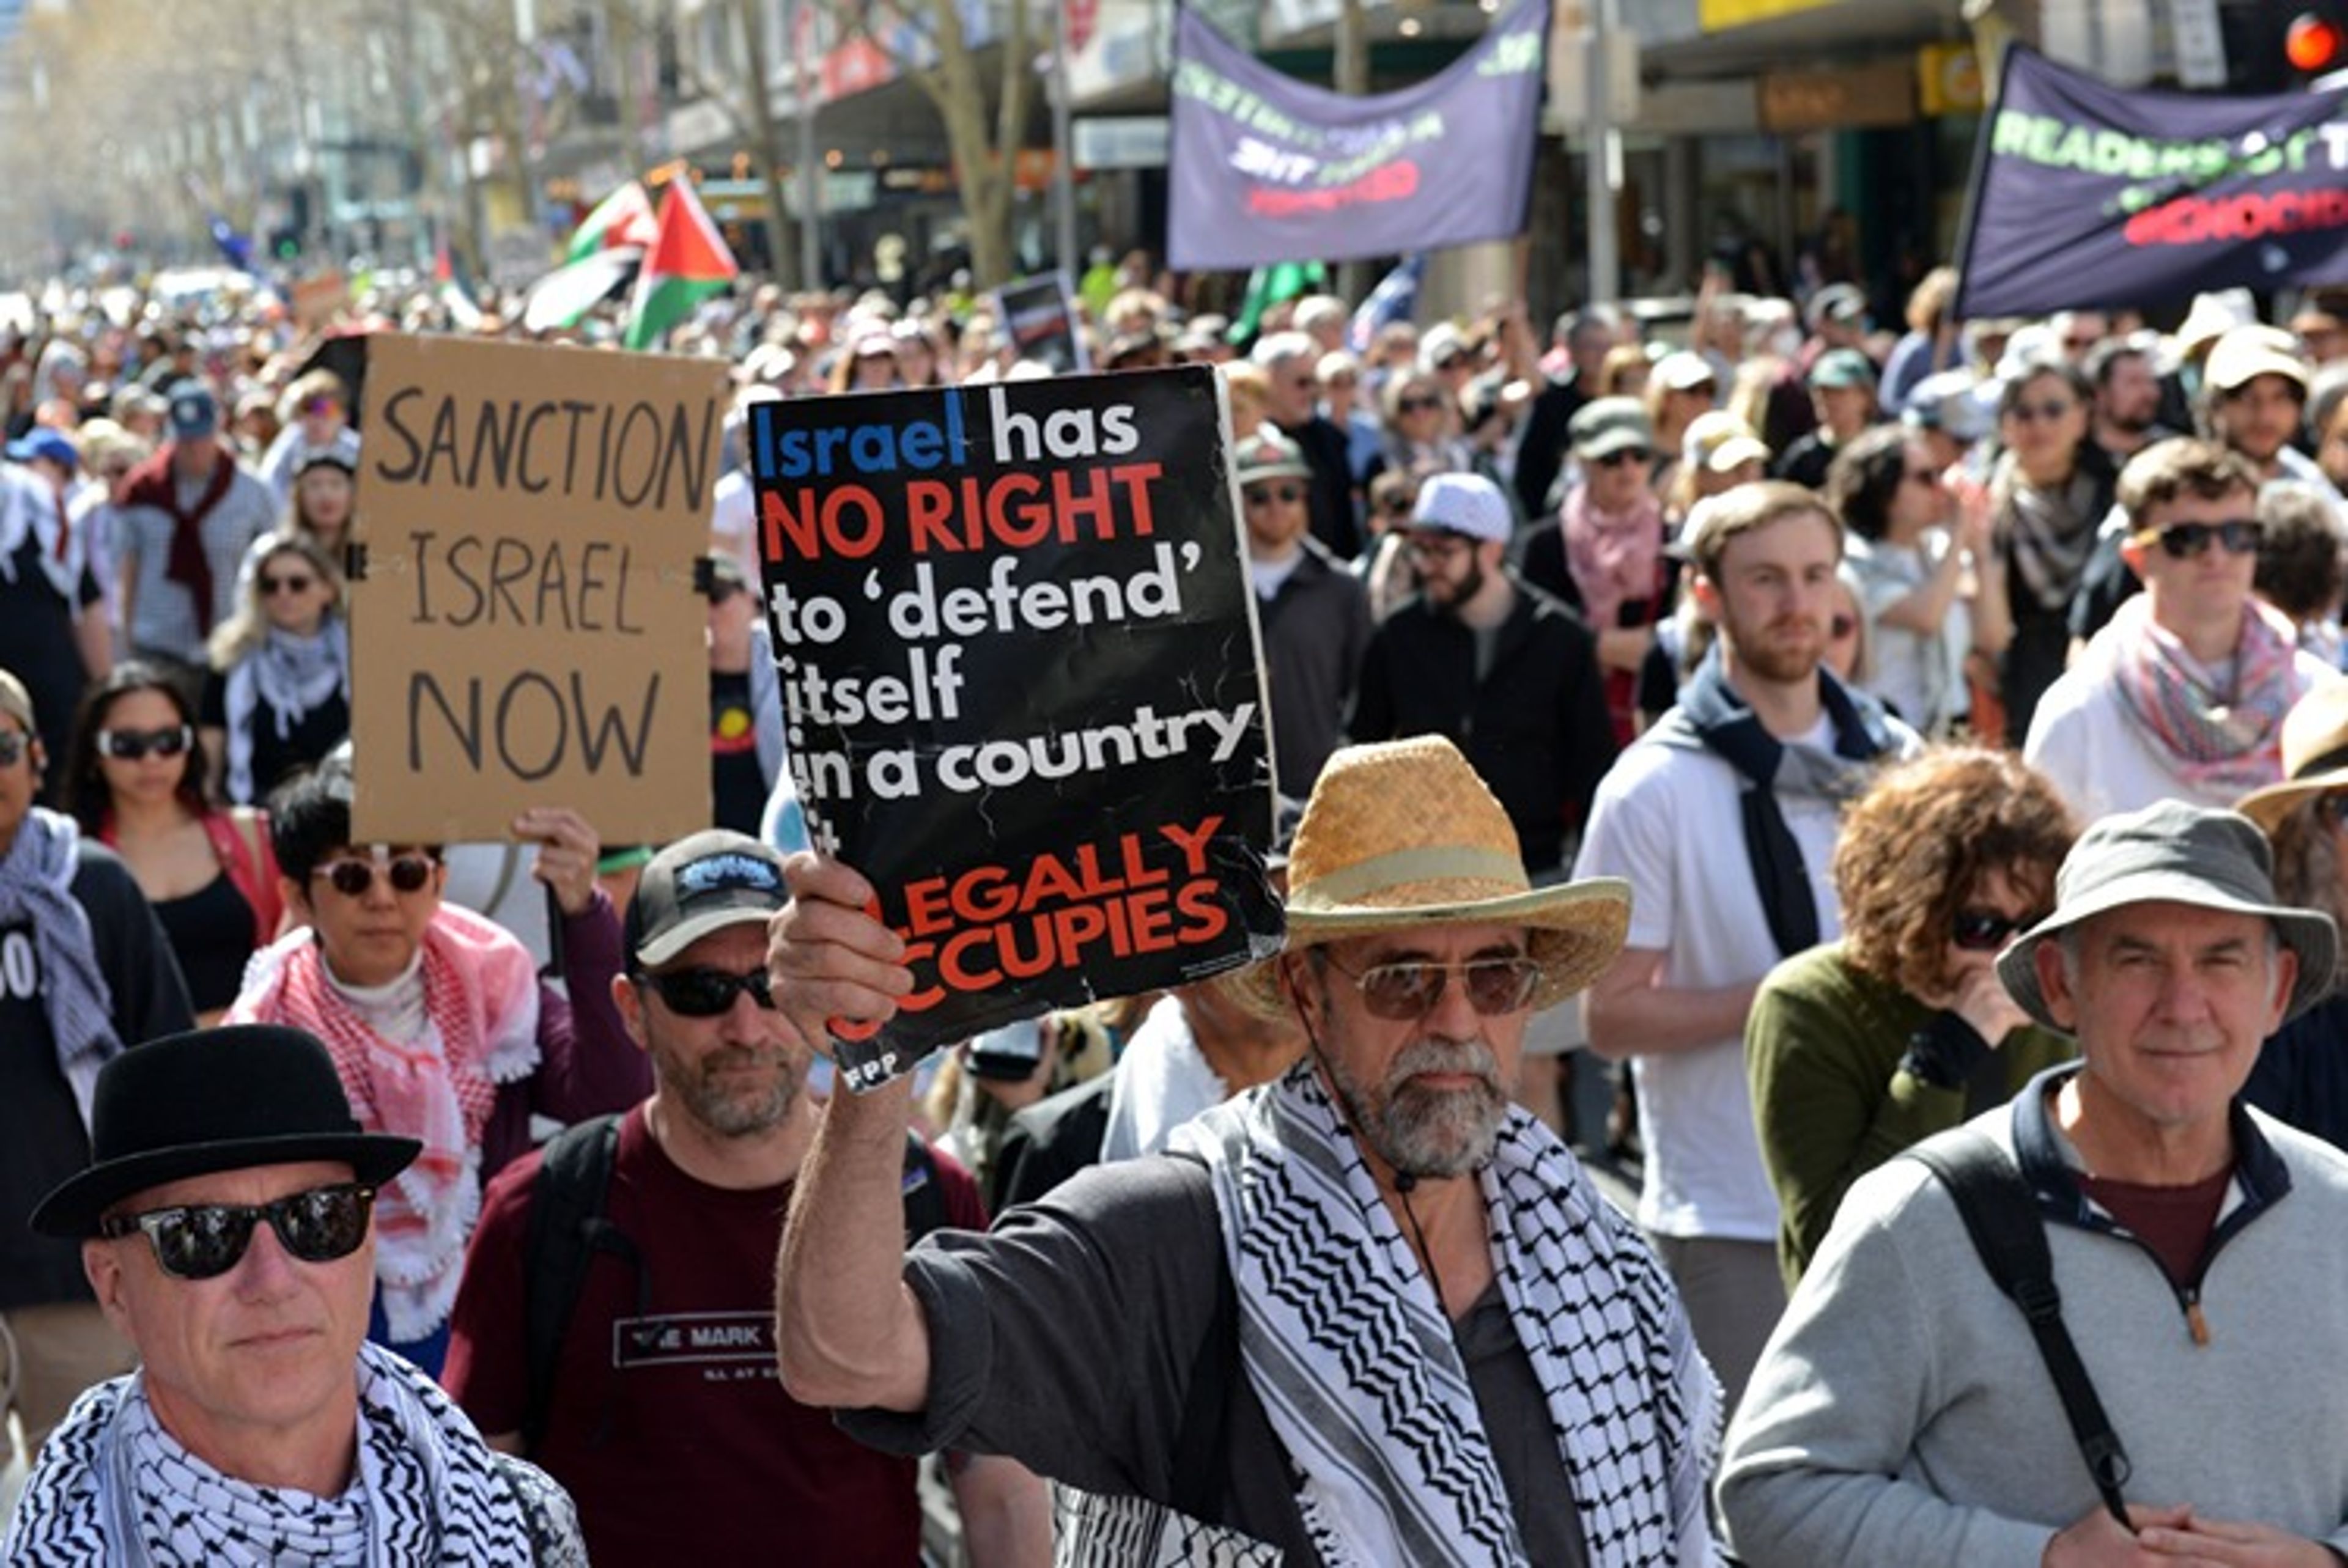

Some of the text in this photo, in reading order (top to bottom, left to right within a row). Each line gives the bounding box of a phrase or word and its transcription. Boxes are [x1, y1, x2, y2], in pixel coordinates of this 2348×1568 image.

[375, 386, 716, 513] SANCTION
[755, 386, 1140, 479] Israel has
[761, 462, 1162, 561] NO RIGHT
[408, 529, 646, 636] ISRAEL
[770, 540, 1202, 644] to ‘defend’
[407, 670, 661, 783] NOW
[780, 644, 964, 725] itself
[788, 702, 1257, 802] in a country
[690, 1325, 762, 1347] MARK
